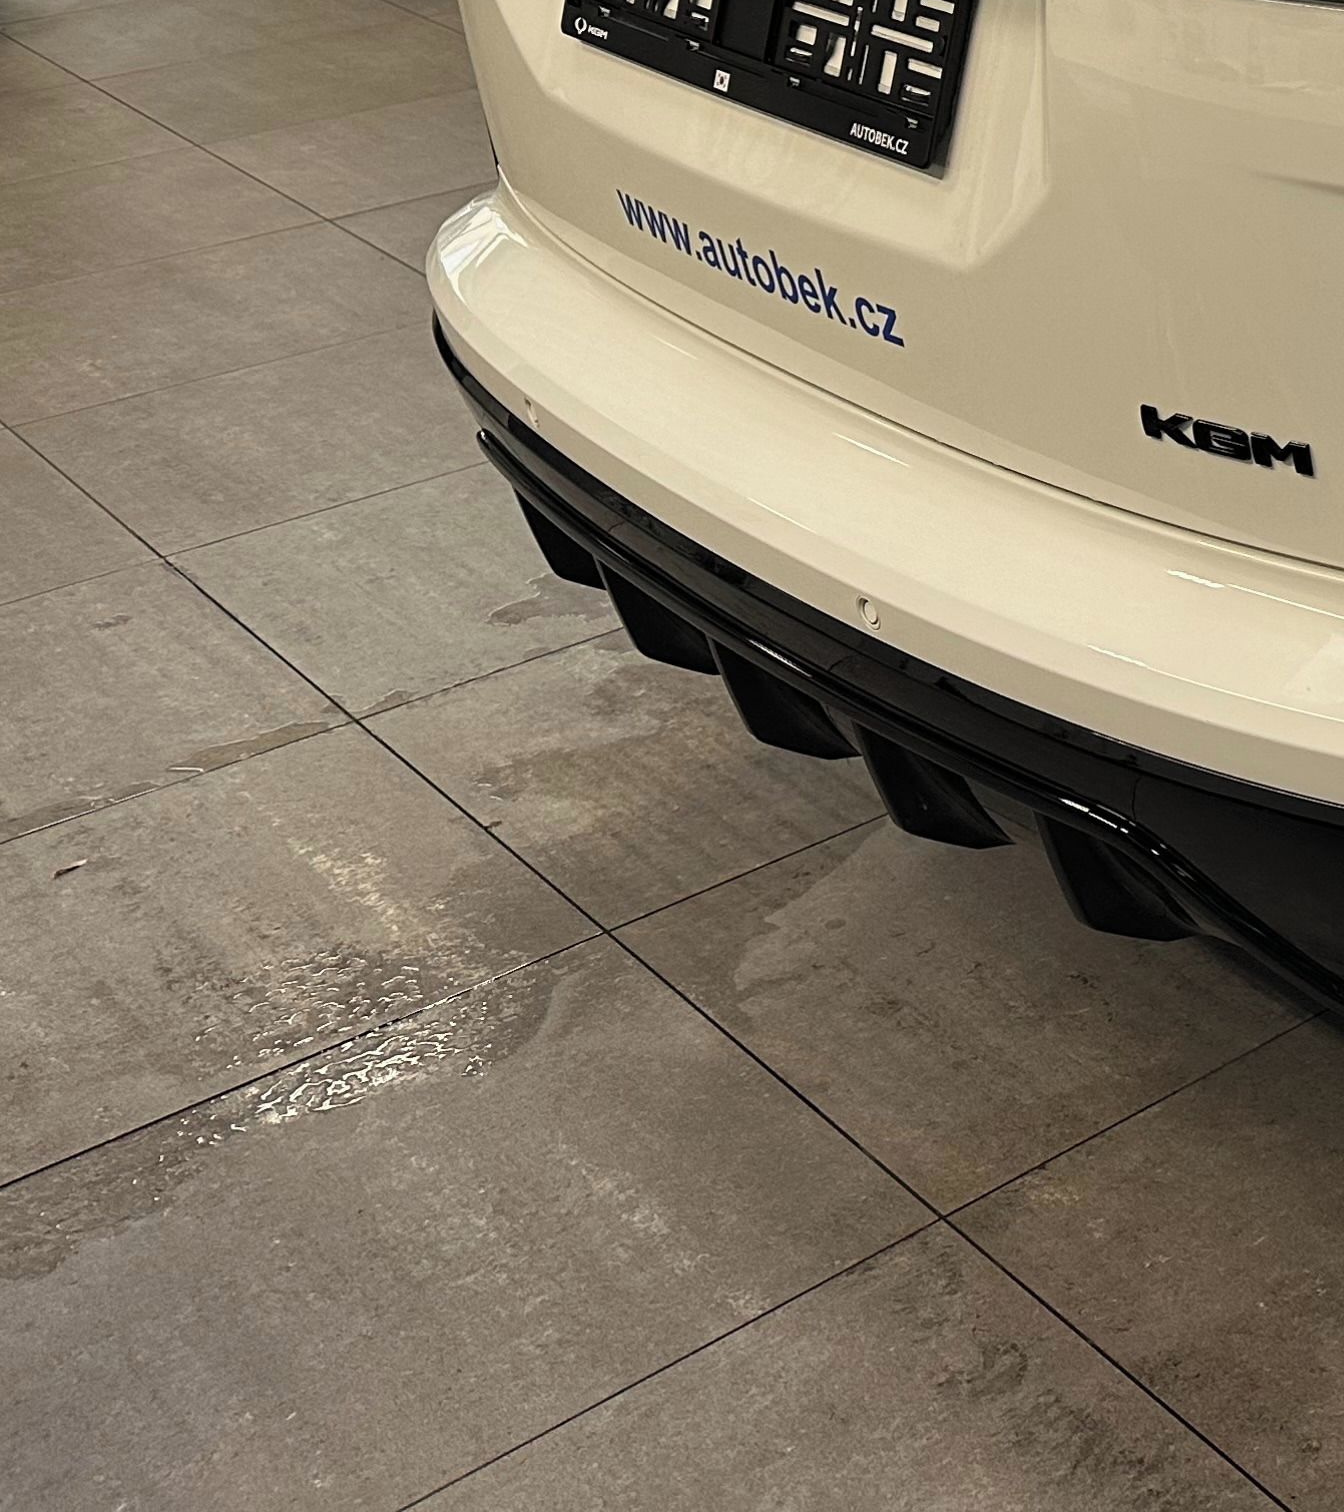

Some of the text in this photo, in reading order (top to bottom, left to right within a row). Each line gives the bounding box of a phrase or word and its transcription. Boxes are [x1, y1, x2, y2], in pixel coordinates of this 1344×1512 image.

[587, 24, 609, 40] KGM
[850, 122, 909, 156] AUTOBEK.CZ
[615, 188, 905, 348] www.autobek.cz
[1139, 403, 1315, 478] KGM
